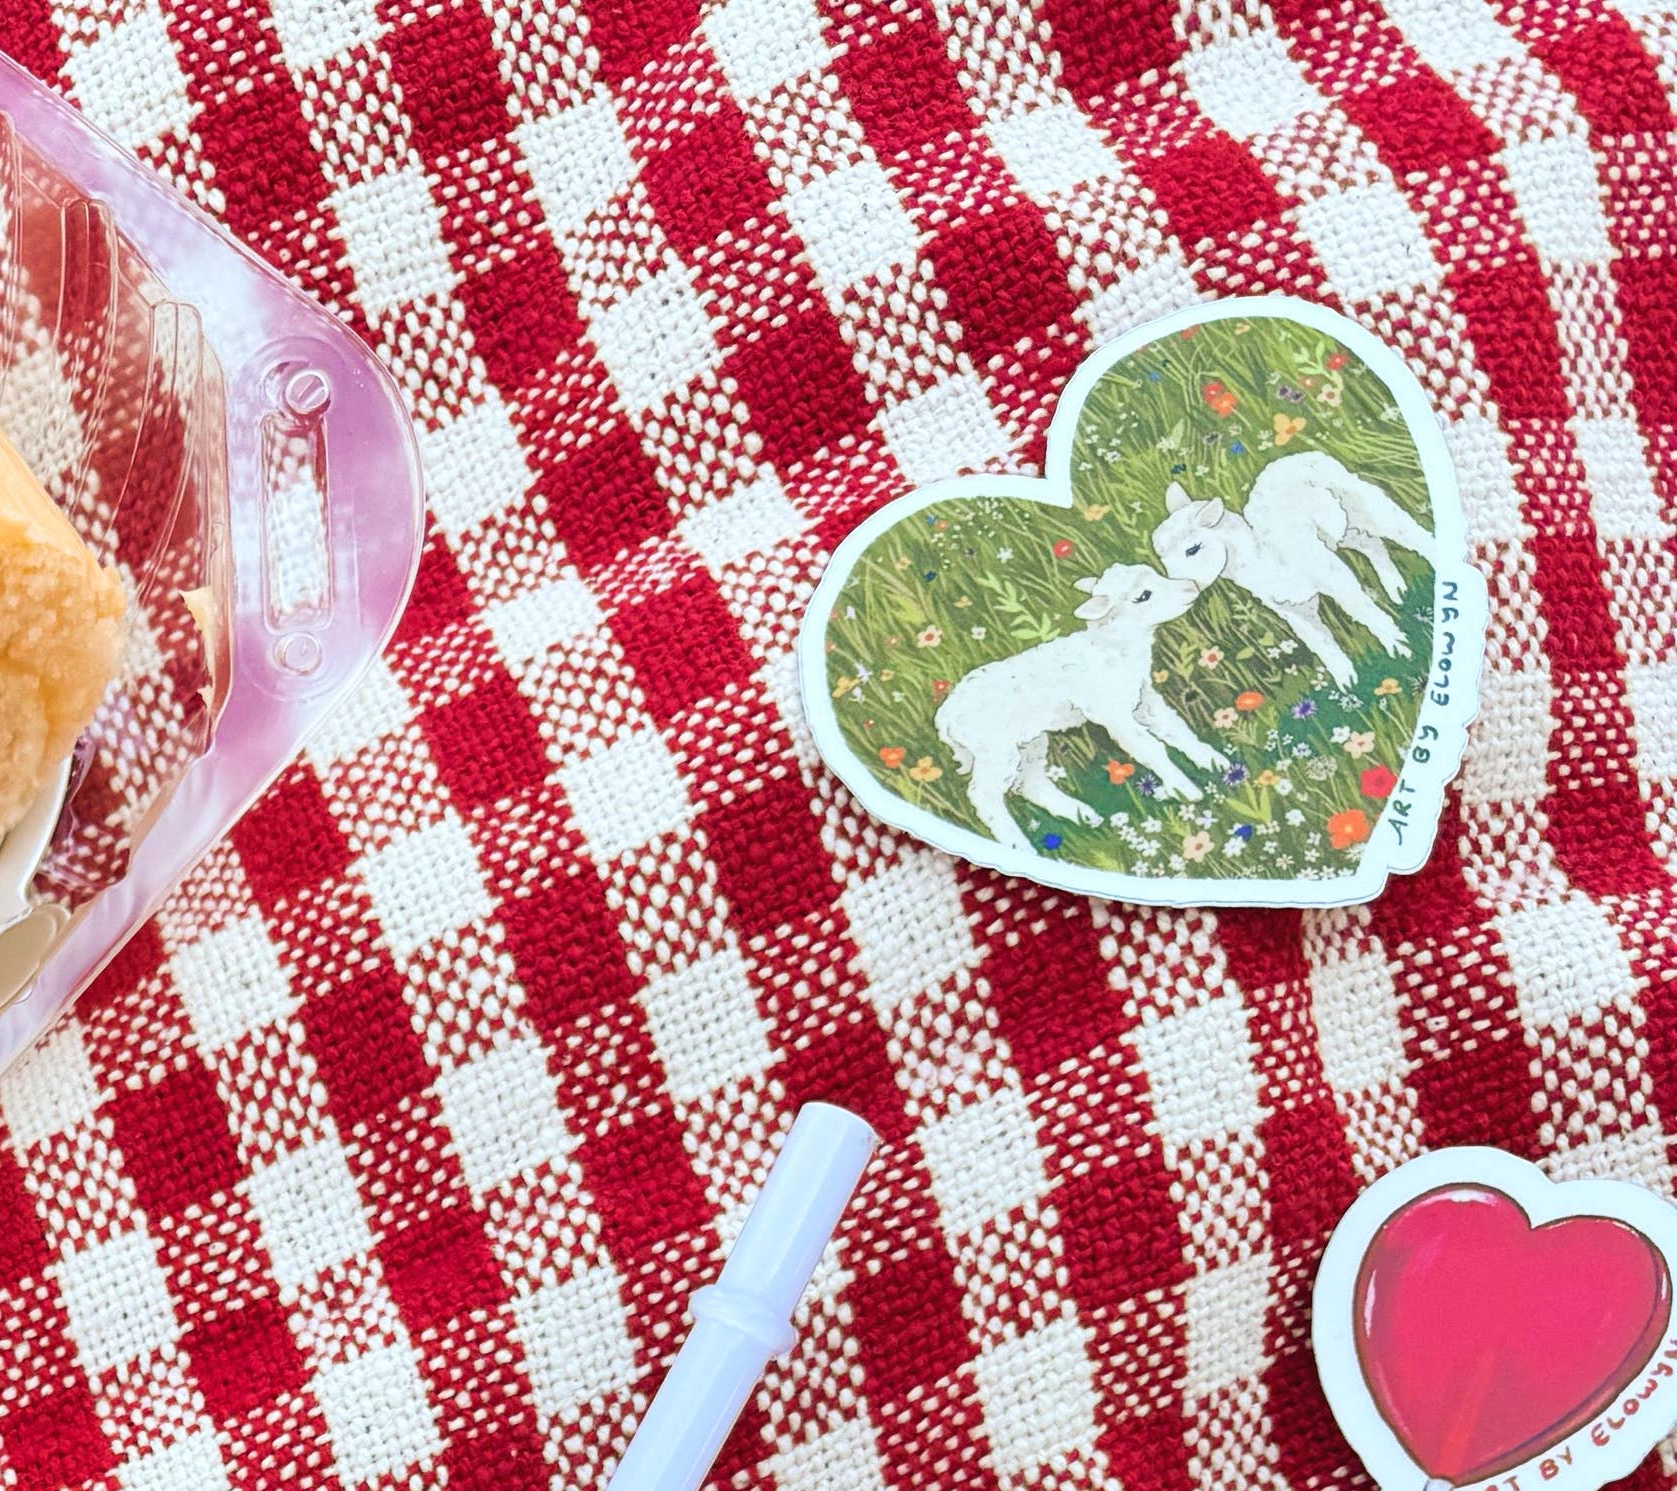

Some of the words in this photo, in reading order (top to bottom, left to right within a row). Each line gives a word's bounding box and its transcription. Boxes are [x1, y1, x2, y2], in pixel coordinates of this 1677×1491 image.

[1388, 778, 1416, 846] ART
[1412, 724, 1439, 764] BY
[1430, 580, 1460, 707] ELOWYN
[1538, 1446, 1573, 1481] BY
